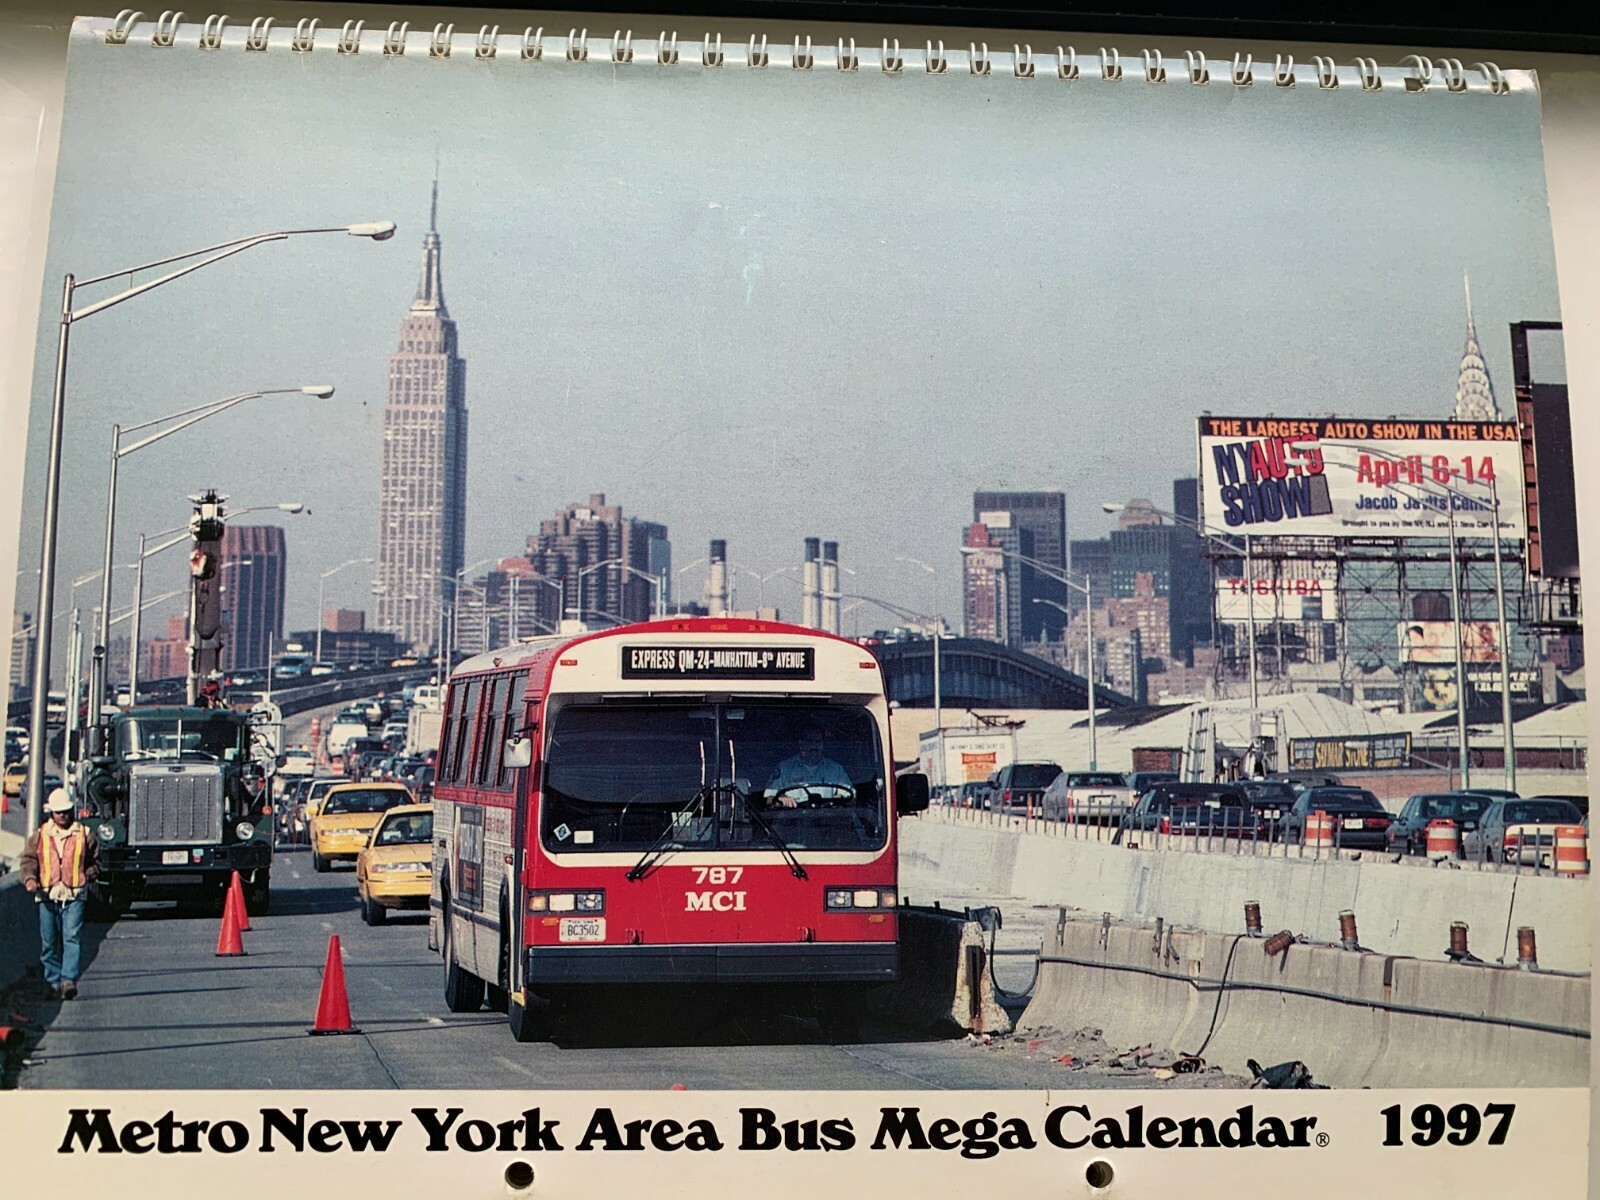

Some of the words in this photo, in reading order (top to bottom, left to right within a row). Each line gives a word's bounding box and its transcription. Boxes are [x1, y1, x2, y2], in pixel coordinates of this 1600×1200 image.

[1209, 420, 1242, 436] THE
[1246, 420, 1319, 438] LARGEST
[1324, 422, 1368, 438] AUTO
[1372, 423, 1420, 440] SHOW
[1424, 424, 1442, 440] IN
[1446, 424, 1478, 440] THE
[1357, 454, 1424, 488] April
[1432, 455, 1496, 484] 6-14
[1220, 475, 1312, 527] SHOW
[1355, 494, 1398, 510] Jacob
[1403, 494, 1447, 511] Javits
[631, 649, 676, 670] EXPRESS
[776, 651, 806, 669] AVENUE
[691, 866, 744, 885] 787
[684, 890, 747, 912] MCI
[567, 924, 600, 937] BC3502
[58, 1109, 250, 1154] Metro
[258, 1108, 403, 1153] New
[411, 1107, 564, 1152] York
[575, 1107, 725, 1152] Area
[738, 1107, 856, 1152] Bus
[869, 1107, 1038, 1160] Mega
[1381, 1103, 1516, 1147] 1997
